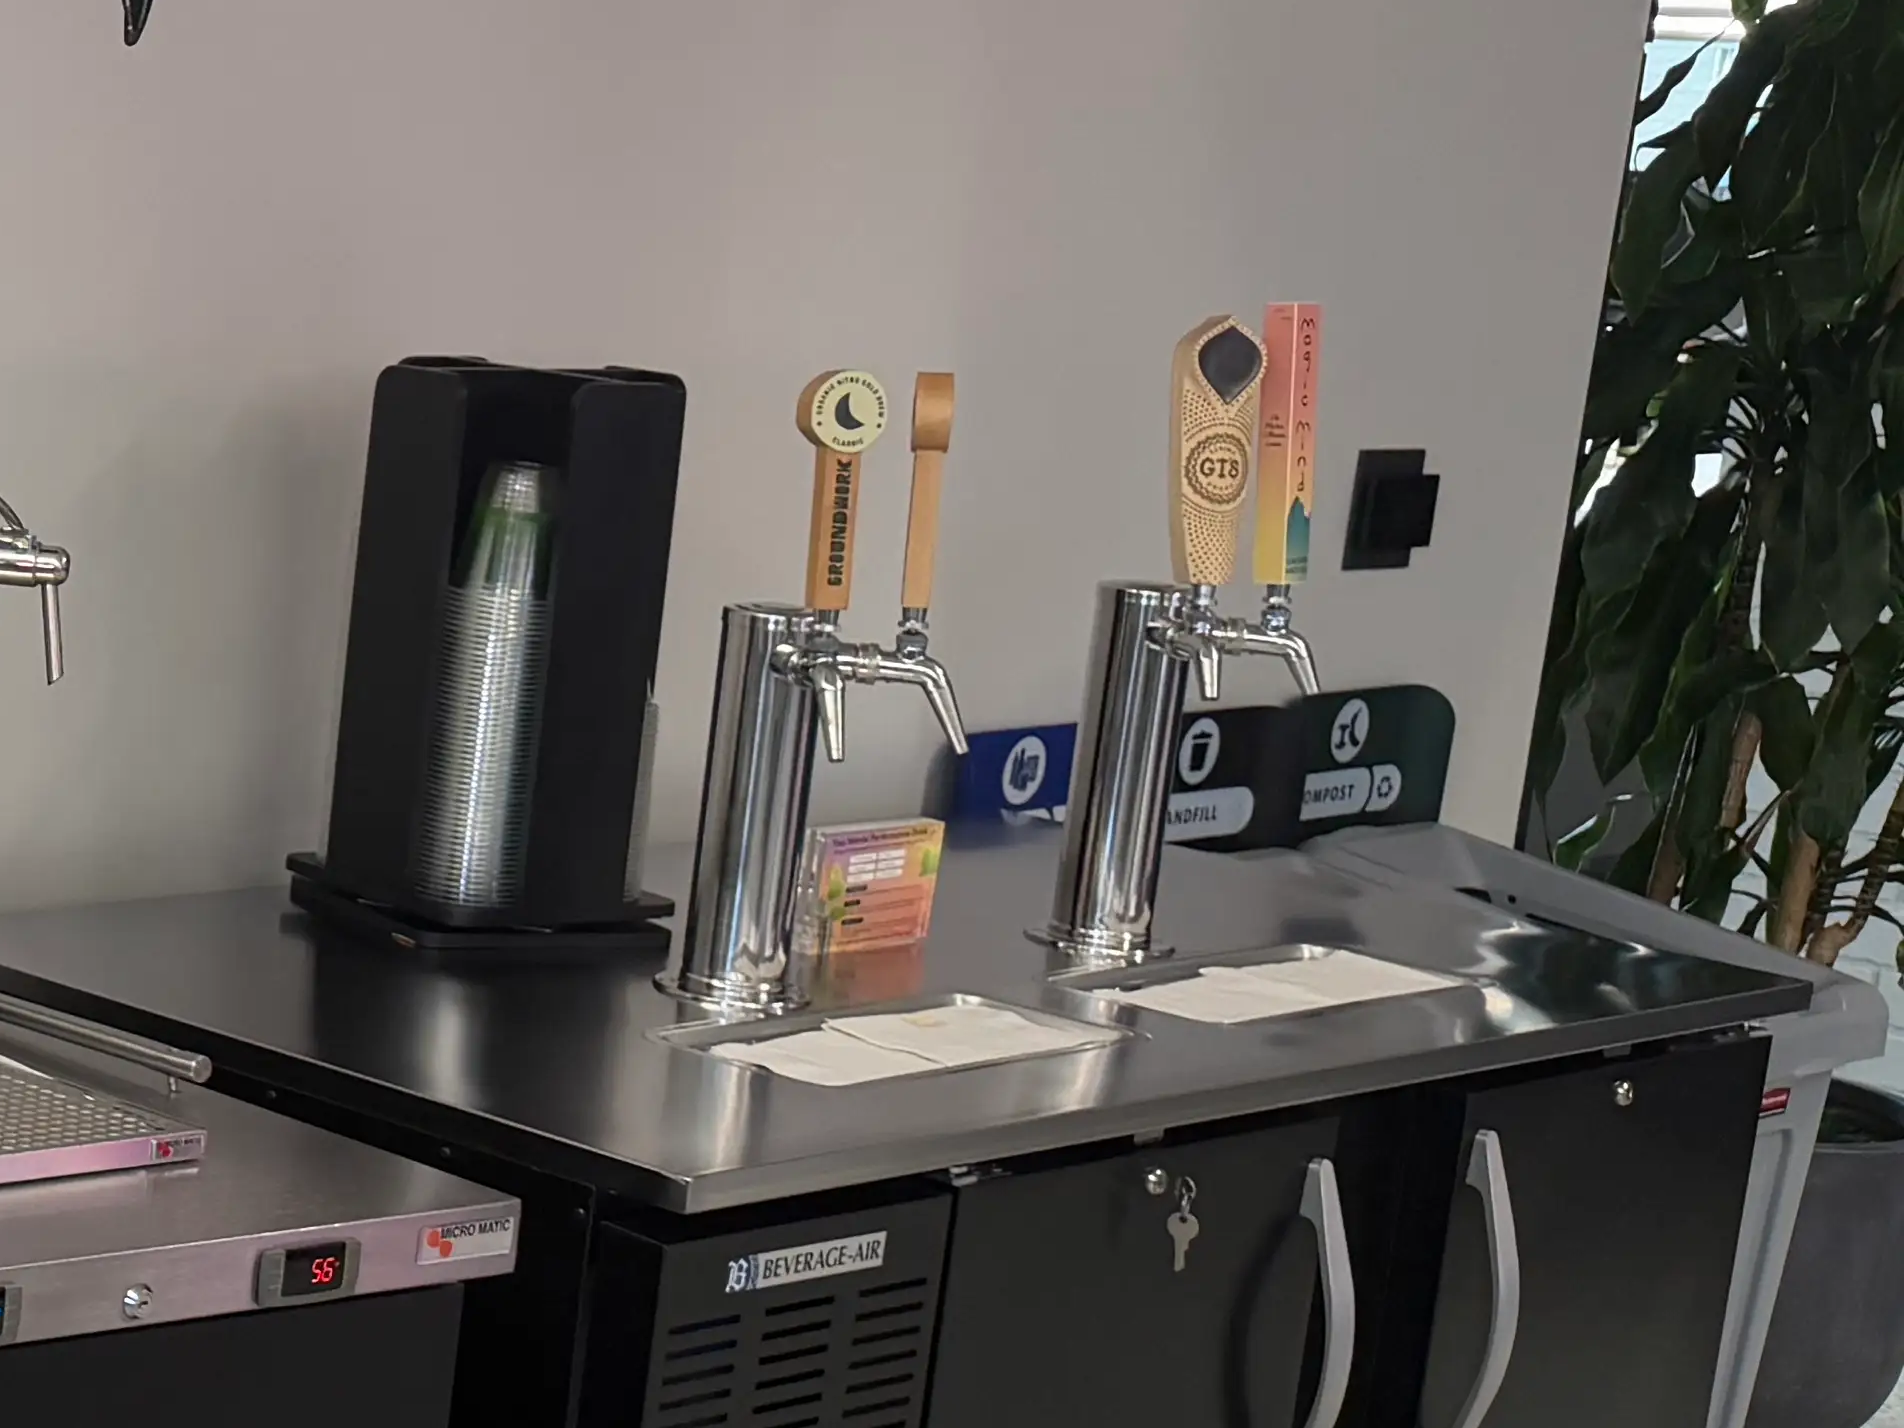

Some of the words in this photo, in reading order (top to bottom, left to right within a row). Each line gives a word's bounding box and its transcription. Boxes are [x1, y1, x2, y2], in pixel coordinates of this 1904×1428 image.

[827, 458, 853, 587] GROUNDWORK
[1303, 784, 1355, 805] OMPOST
[1167, 804, 1217, 825] ANDFILL
[440, 1224, 476, 1239] MICRO
[478, 1219, 512, 1234] MATIC
[762, 1239, 881, 1280] BEVERAGE-AIR
